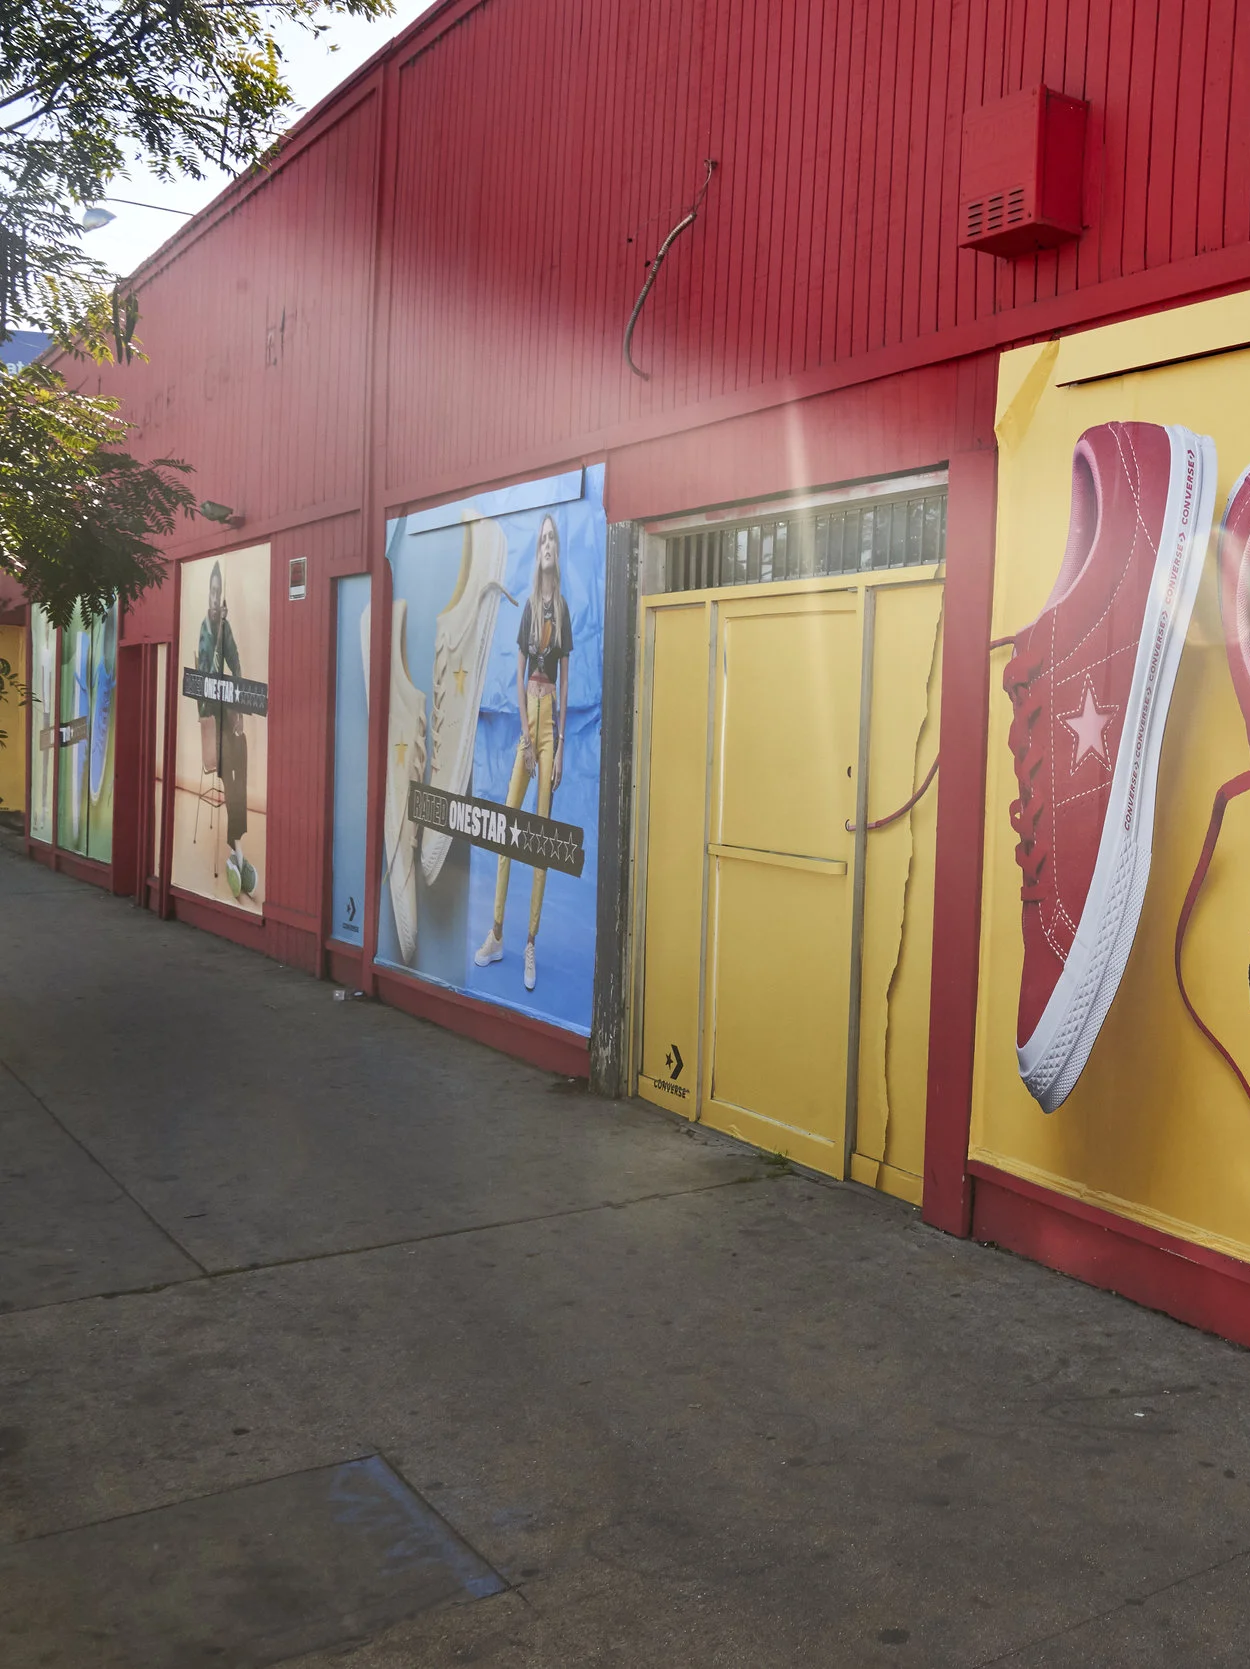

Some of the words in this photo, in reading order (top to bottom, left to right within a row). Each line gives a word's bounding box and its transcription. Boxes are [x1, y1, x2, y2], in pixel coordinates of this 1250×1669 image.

[1124, 773, 1137, 832] CONVERSE
[1136, 695, 1150, 758] CONVERSE
[1149, 622, 1166, 681] CONVERSE
[1165, 544, 1184, 605] CONVERSE
[1181, 460, 1195, 525] CONVERSE
[413, 789, 449, 827] RATED
